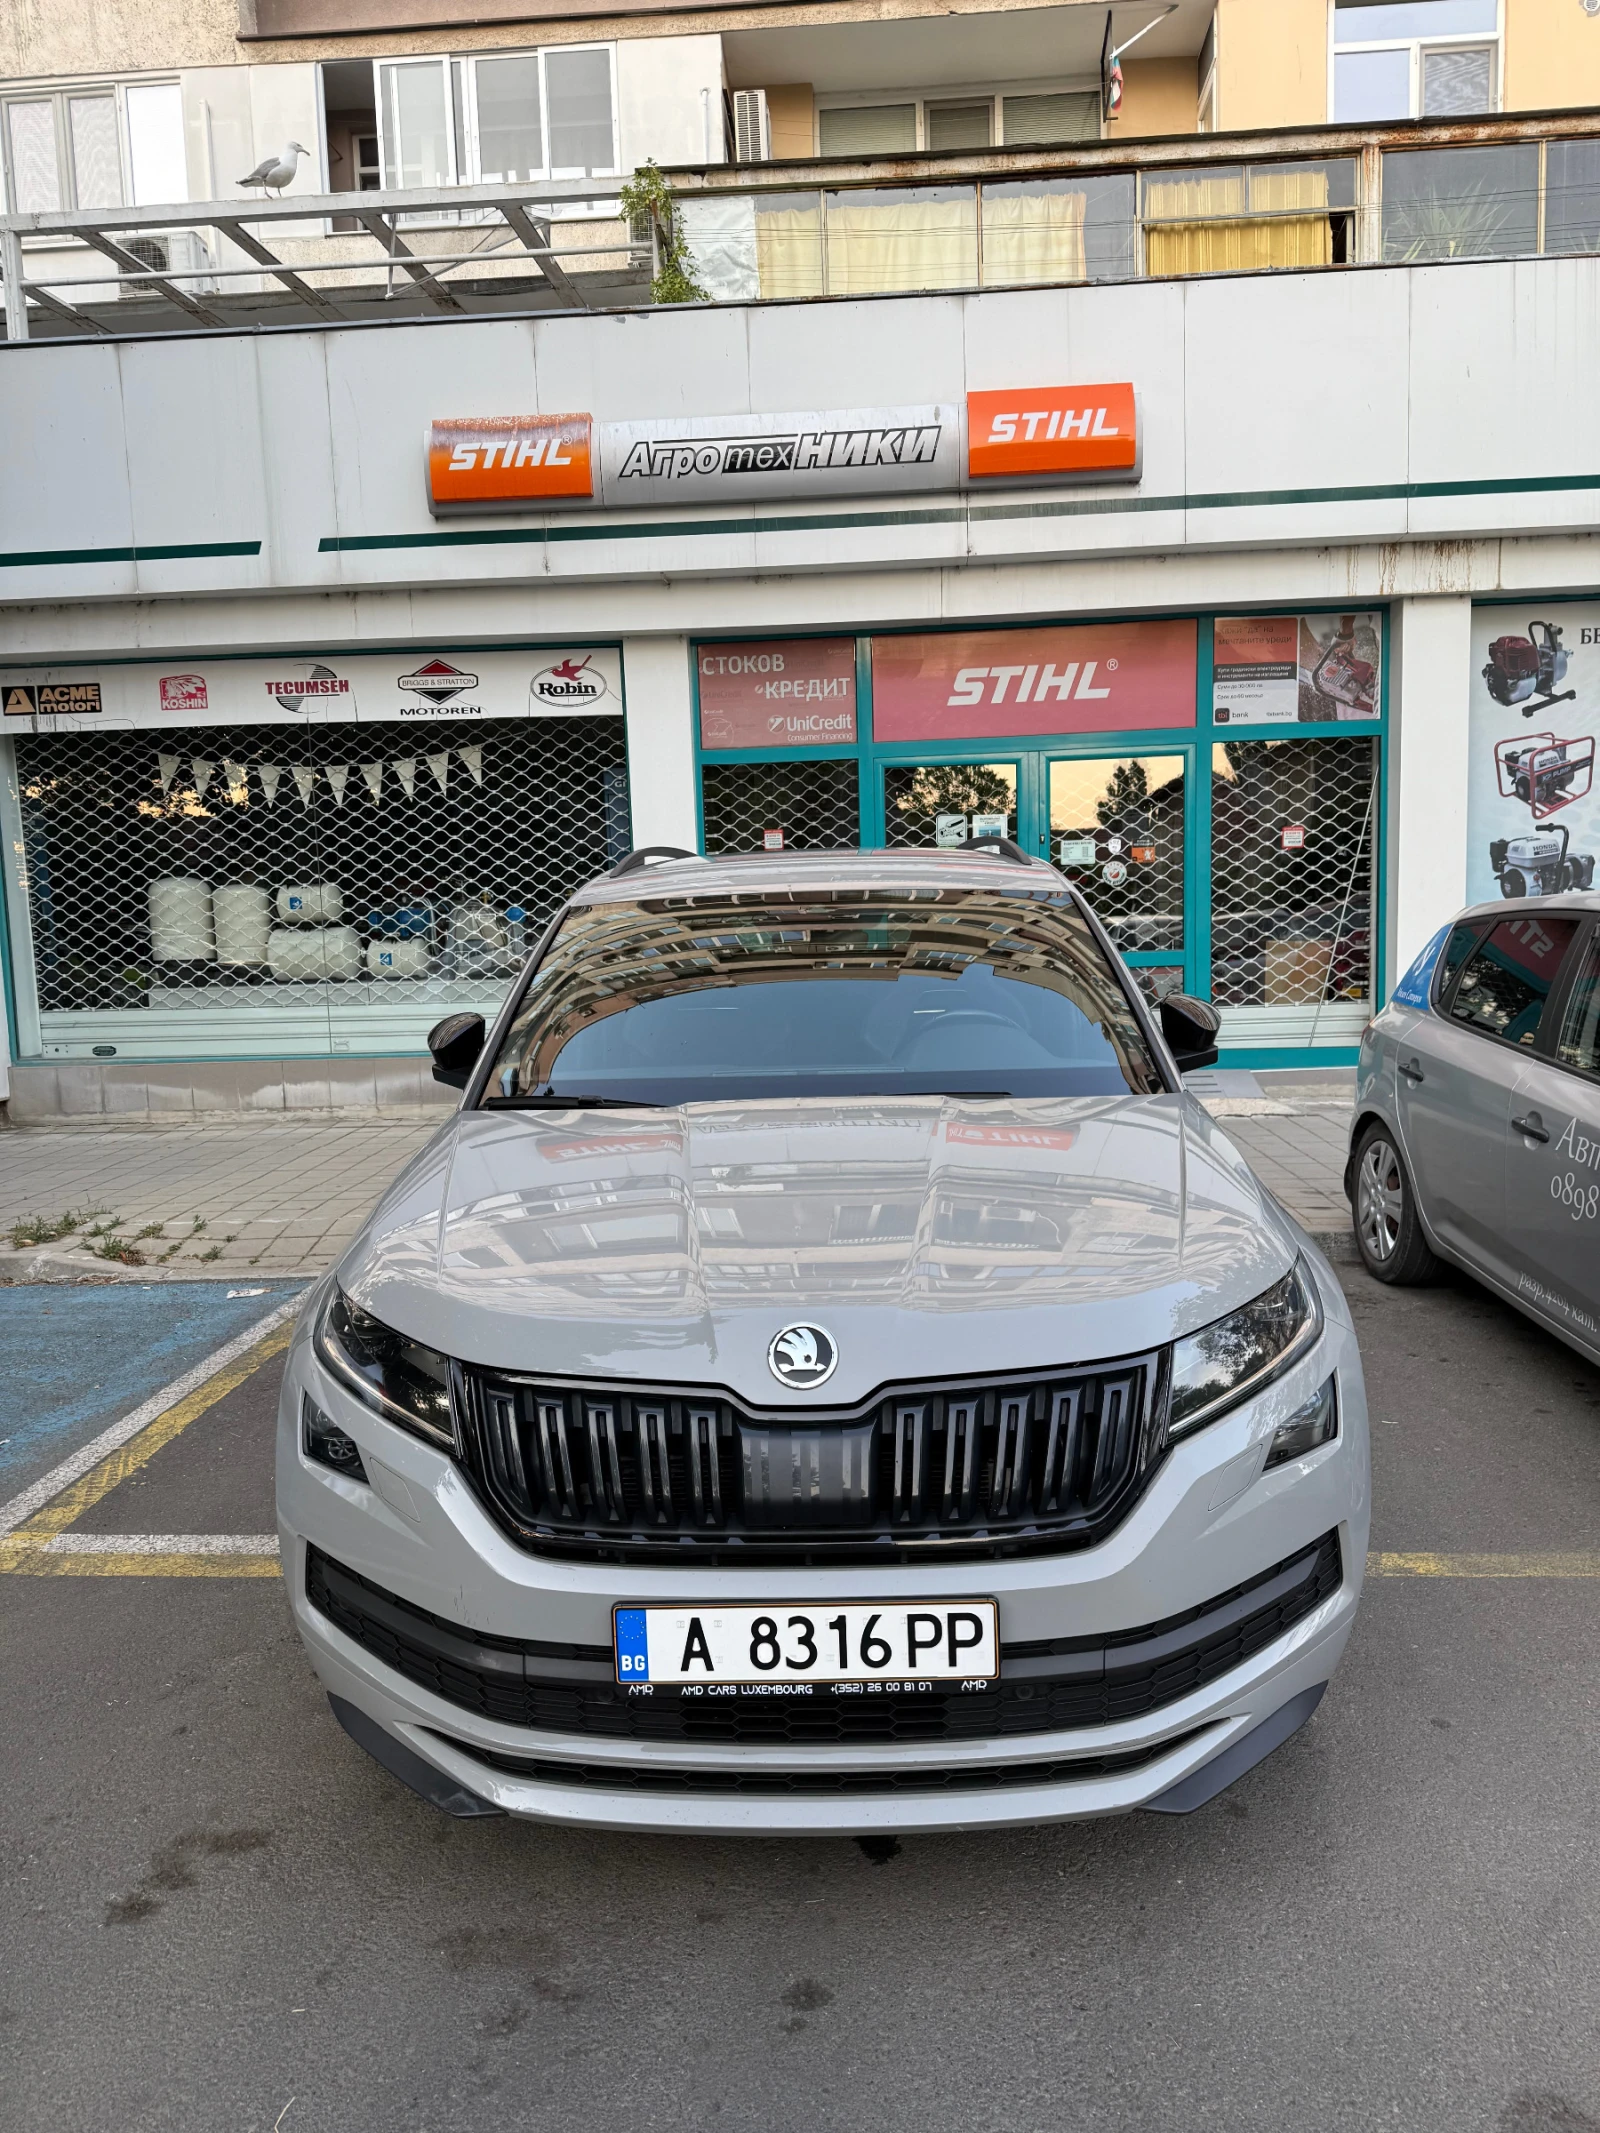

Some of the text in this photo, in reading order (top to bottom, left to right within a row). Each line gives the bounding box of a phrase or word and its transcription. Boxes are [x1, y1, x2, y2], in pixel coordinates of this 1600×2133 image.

[988, 408, 1119, 443] STIHL
[1265, 636, 1292, 645] уреди
[702, 653, 785, 675] СТОКОВ
[265, 679, 350, 695] TECUMSEH
[401, 679, 429, 687] BRIGGS
[437, 678, 475, 686] STRATTON
[538, 682, 597, 696] Robin
[765, 677, 851, 701] КРЕДИТ
[39, 686, 100, 702] ACME
[39, 700, 100, 713] motori
[161, 698, 207, 710] KOSHIN
[400, 706, 482, 716] MOTOREN
[786, 713, 853, 732] UniCredit
[1532, 843, 1557, 851] HONDA
[1550, 1172, 1600, 1221] 0898
[621, 1612, 984, 1672] BG A 8316 PP
[681, 1682, 933, 1696] AMD CARS LUXEMBOURG +(352) 26 00 81 07
